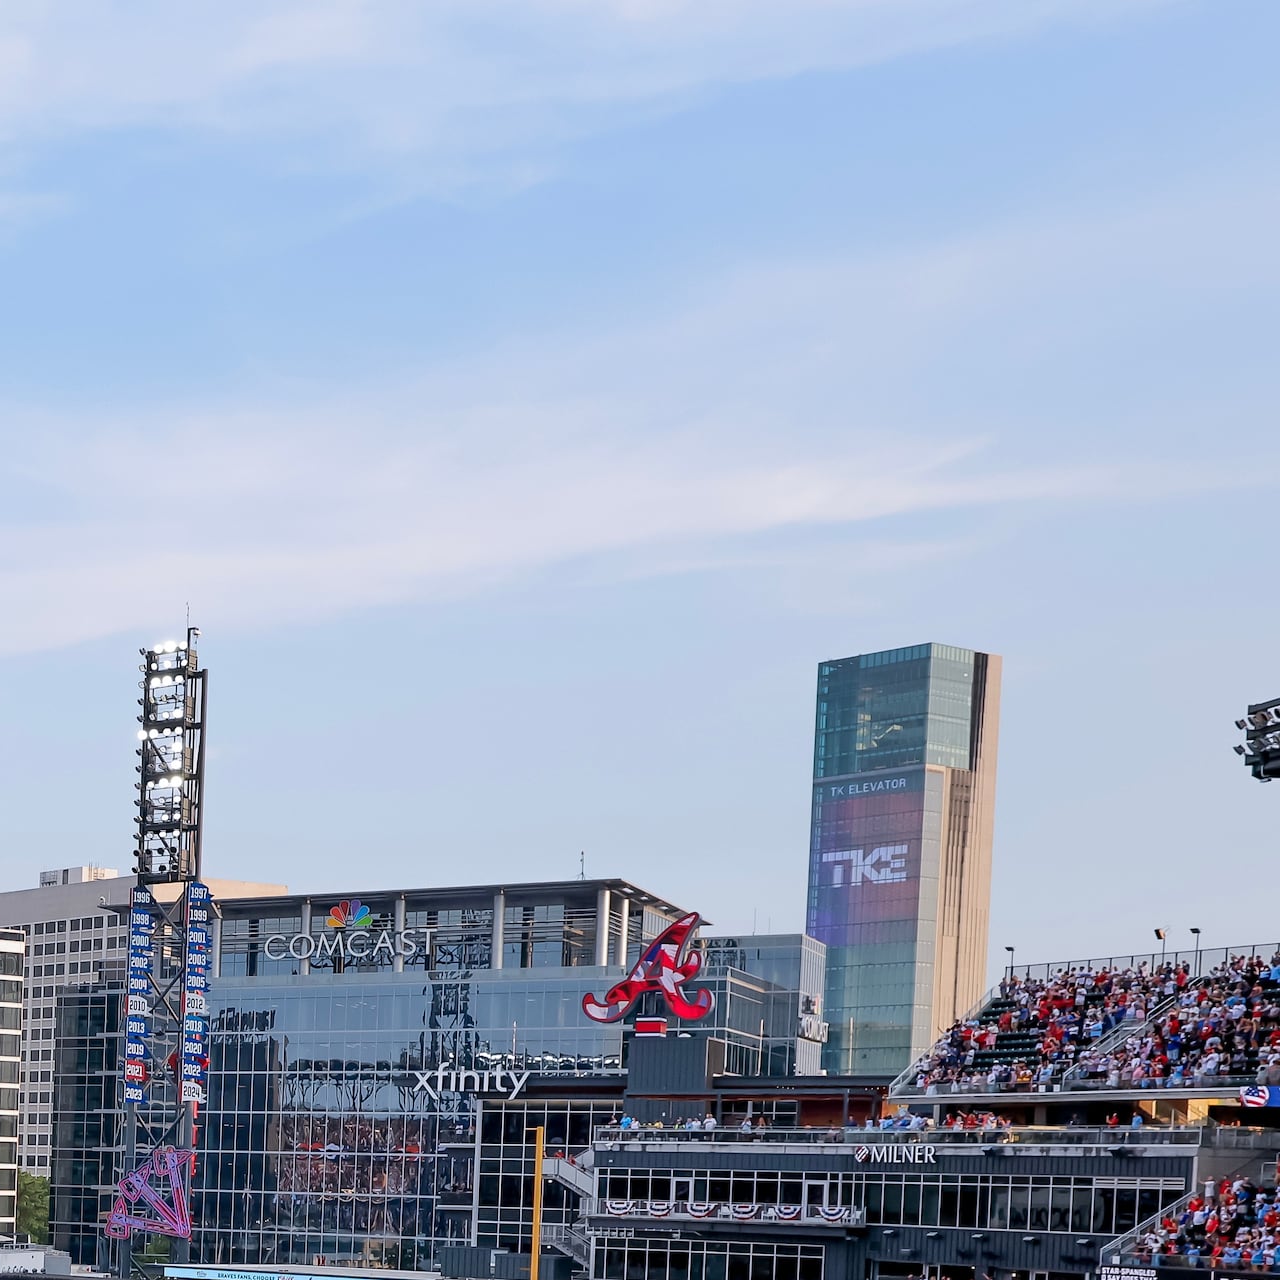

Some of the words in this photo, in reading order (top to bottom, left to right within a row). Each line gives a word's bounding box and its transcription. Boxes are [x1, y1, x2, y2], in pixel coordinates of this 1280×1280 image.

[831, 786, 844, 796] TK
[848, 778, 906, 794] ELEVATOR
[822, 844, 908, 888] TKE
[190, 887, 207, 899] 1997
[133, 913, 149, 925] 1998
[190, 909, 207, 921] 1999
[131, 935, 149, 946] 2000
[264, 928, 438, 960] COMCAST
[130, 978, 147, 990] 2004
[188, 976, 205, 987] 2005
[129, 1000, 146, 1012] 2010
[187, 997, 203, 1009] 2012
[128, 1022, 145, 1033] 2013
[186, 1020, 202, 1032] 2018
[185, 1042, 202, 1054] 2020
[127, 1065, 143, 1077] 2021
[184, 1064, 201, 1076] 2022
[412, 1062, 530, 1100] xfinity
[126, 1088, 142, 1100] 2023
[871, 1145, 936, 1164] MILNER
[1102, 1267, 1156, 1277] STAR-SPANGLED
